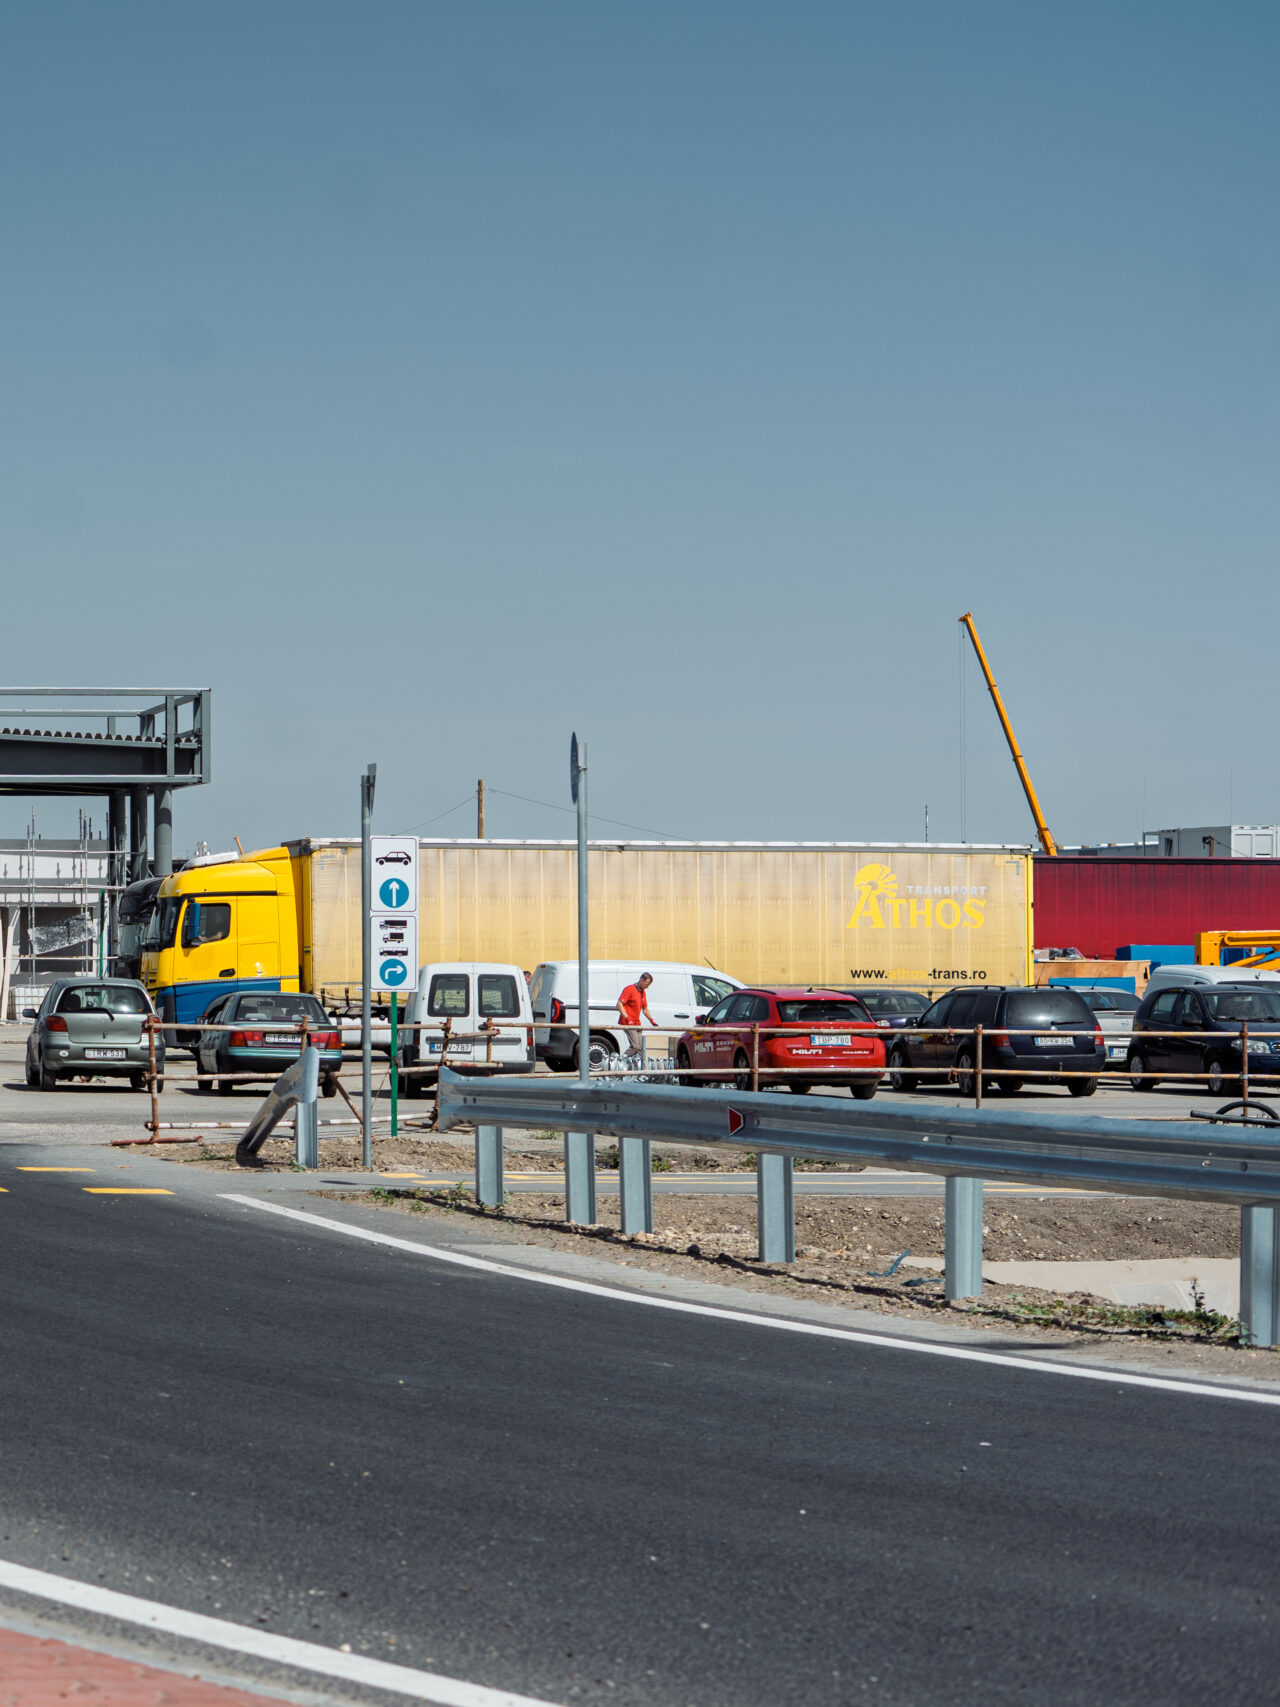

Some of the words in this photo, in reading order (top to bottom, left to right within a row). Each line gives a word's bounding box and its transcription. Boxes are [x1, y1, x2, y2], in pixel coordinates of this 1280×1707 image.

[907, 885, 987, 895] TRANSPORT
[846, 886, 987, 930] ATHOS
[850, 967, 987, 979] www.athos-trans.ro
